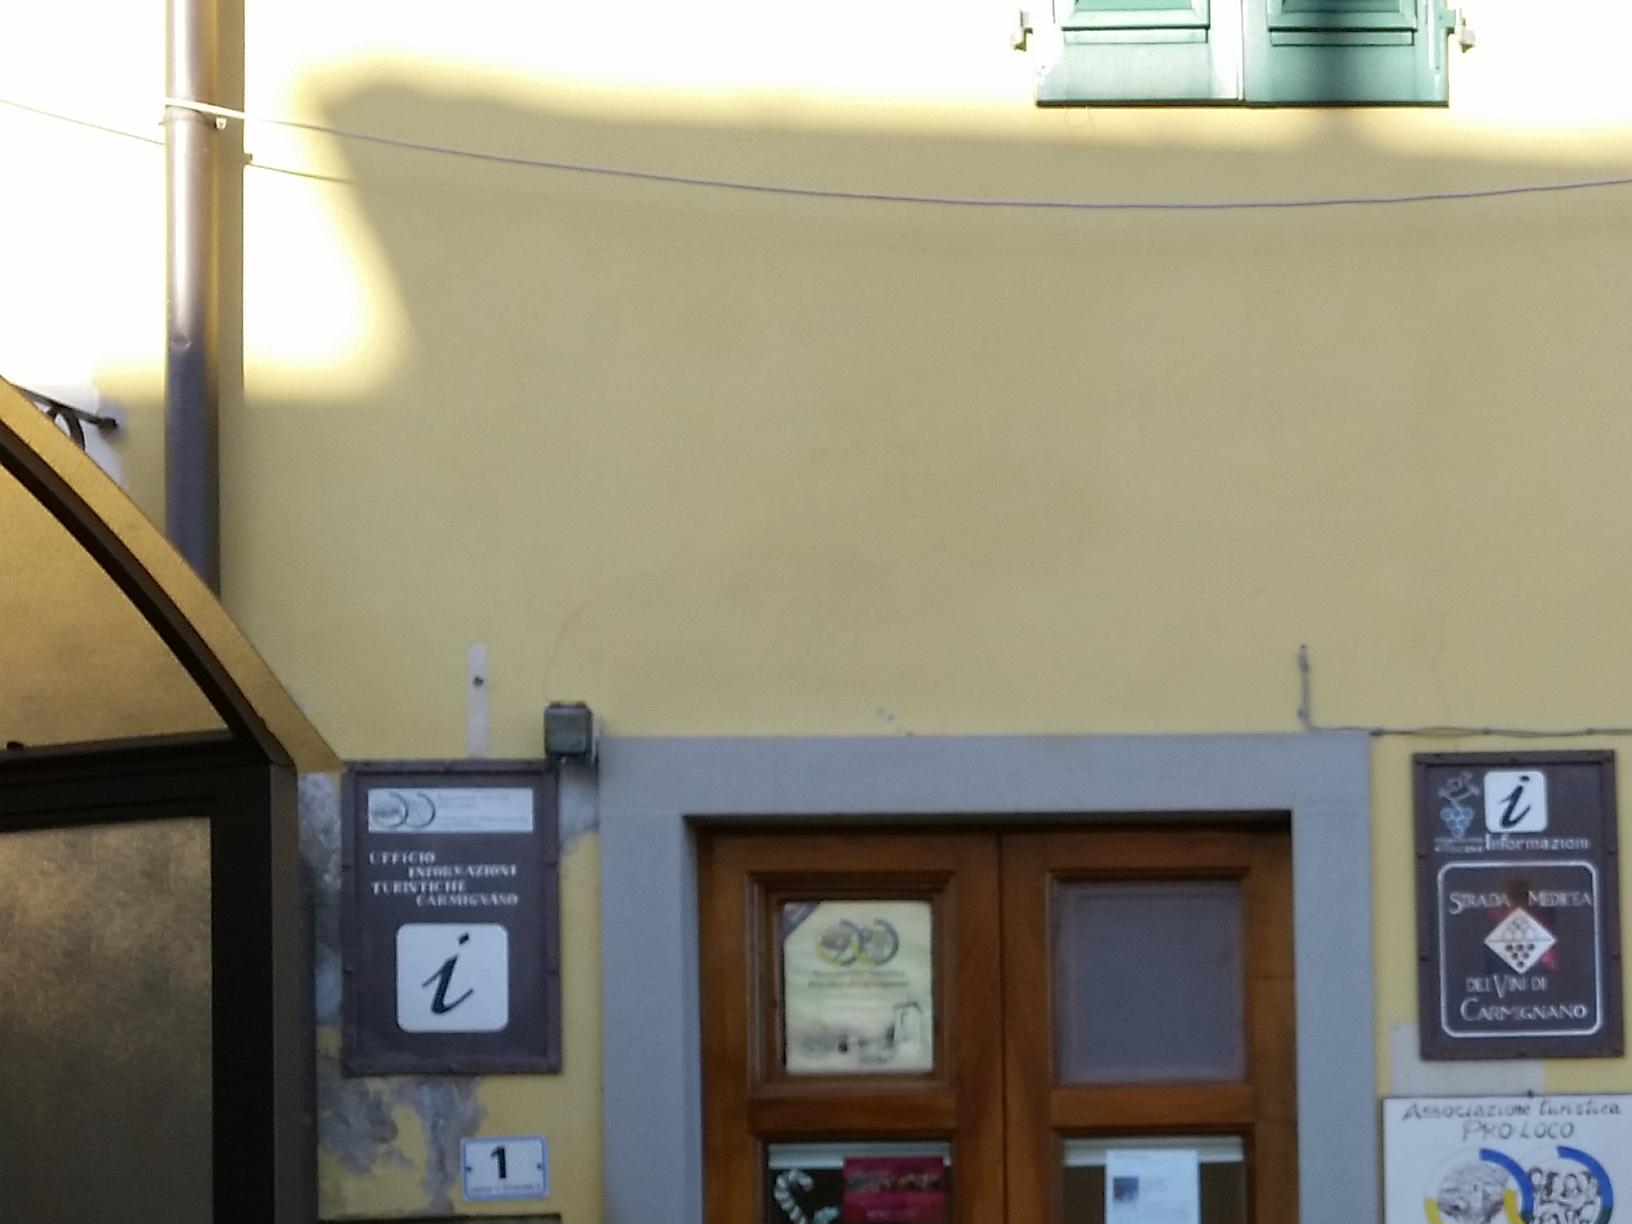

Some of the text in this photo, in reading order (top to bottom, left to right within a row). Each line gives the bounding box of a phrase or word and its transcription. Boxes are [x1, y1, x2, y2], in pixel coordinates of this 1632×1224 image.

[369, 851, 436, 865] UFFICIO
[1460, 997, 1588, 1021] CARMIGNANO
[1402, 1103, 1531, 1121] Associazione
[1520, 1121, 1574, 1139] LOCO
[490, 1146, 507, 1179] 1
